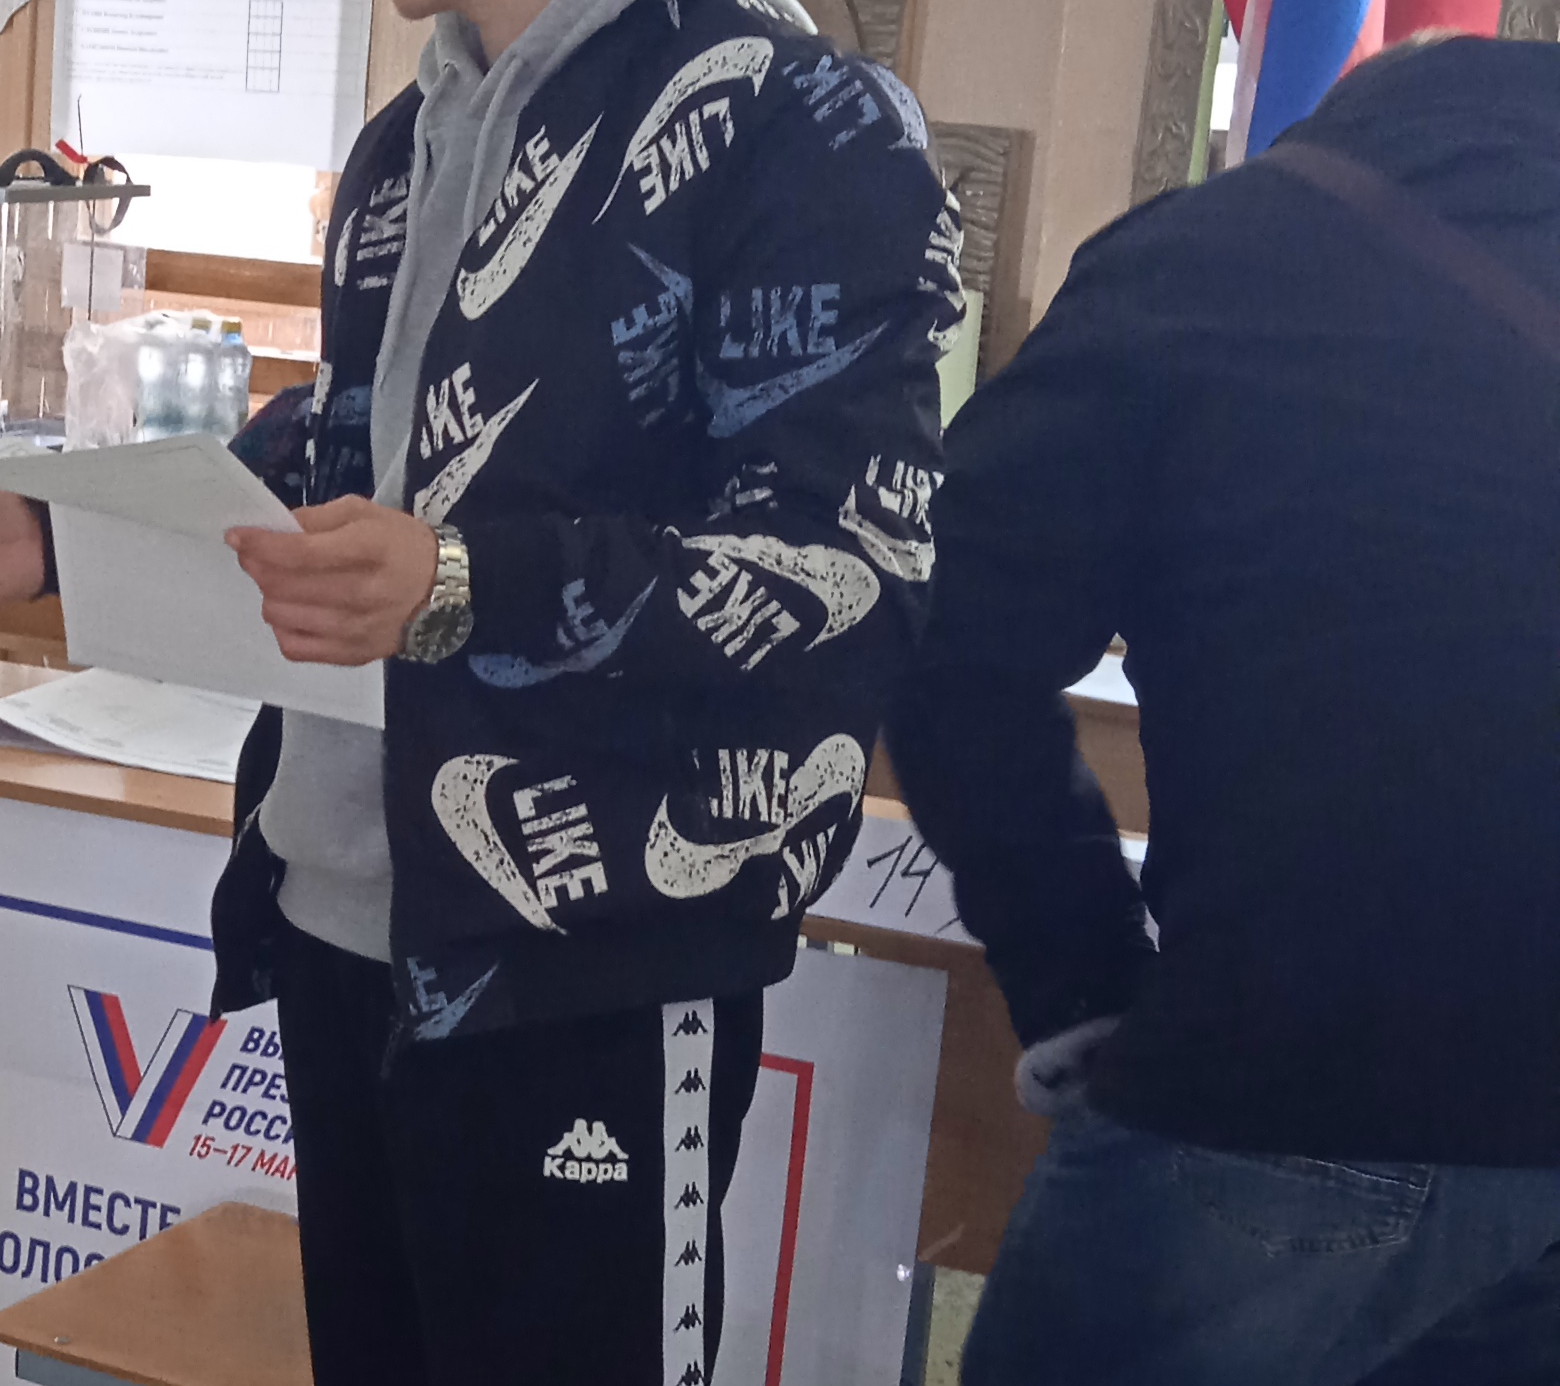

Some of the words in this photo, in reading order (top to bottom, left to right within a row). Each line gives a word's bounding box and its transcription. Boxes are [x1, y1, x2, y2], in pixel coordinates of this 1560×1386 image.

[633, 96, 736, 216] LIKE
[719, 282, 841, 360] LIKE
[513, 773, 610, 910] LIKE
[543, 1154, 629, 1184] Kappa
